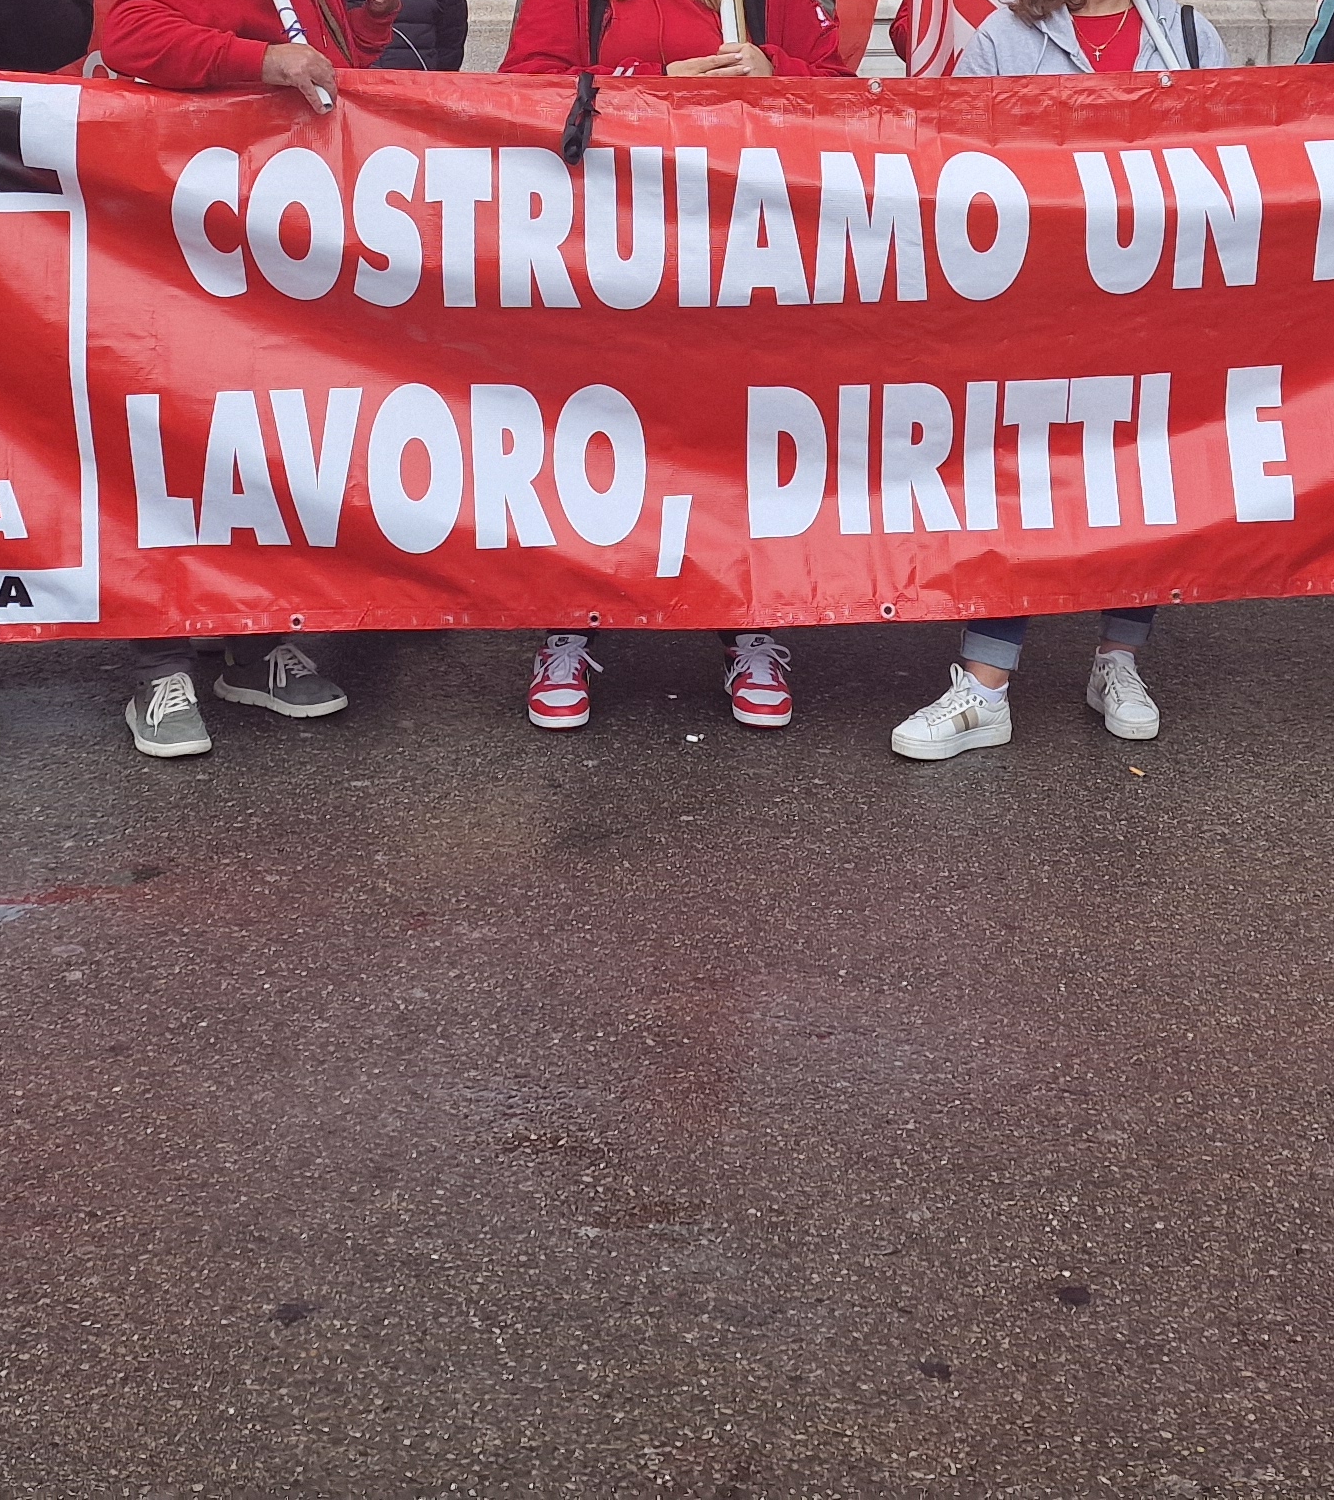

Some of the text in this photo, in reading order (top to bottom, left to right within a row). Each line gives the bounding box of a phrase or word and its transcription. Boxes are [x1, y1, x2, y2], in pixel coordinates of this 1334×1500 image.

[170, 145, 1030, 311] COSTRUIAMO
[1073, 145, 1264, 294] UN
[126, 382, 693, 579] LAVORO,
[747, 372, 1178, 538] DIRITTI
[1225, 365, 1297, 523] E
